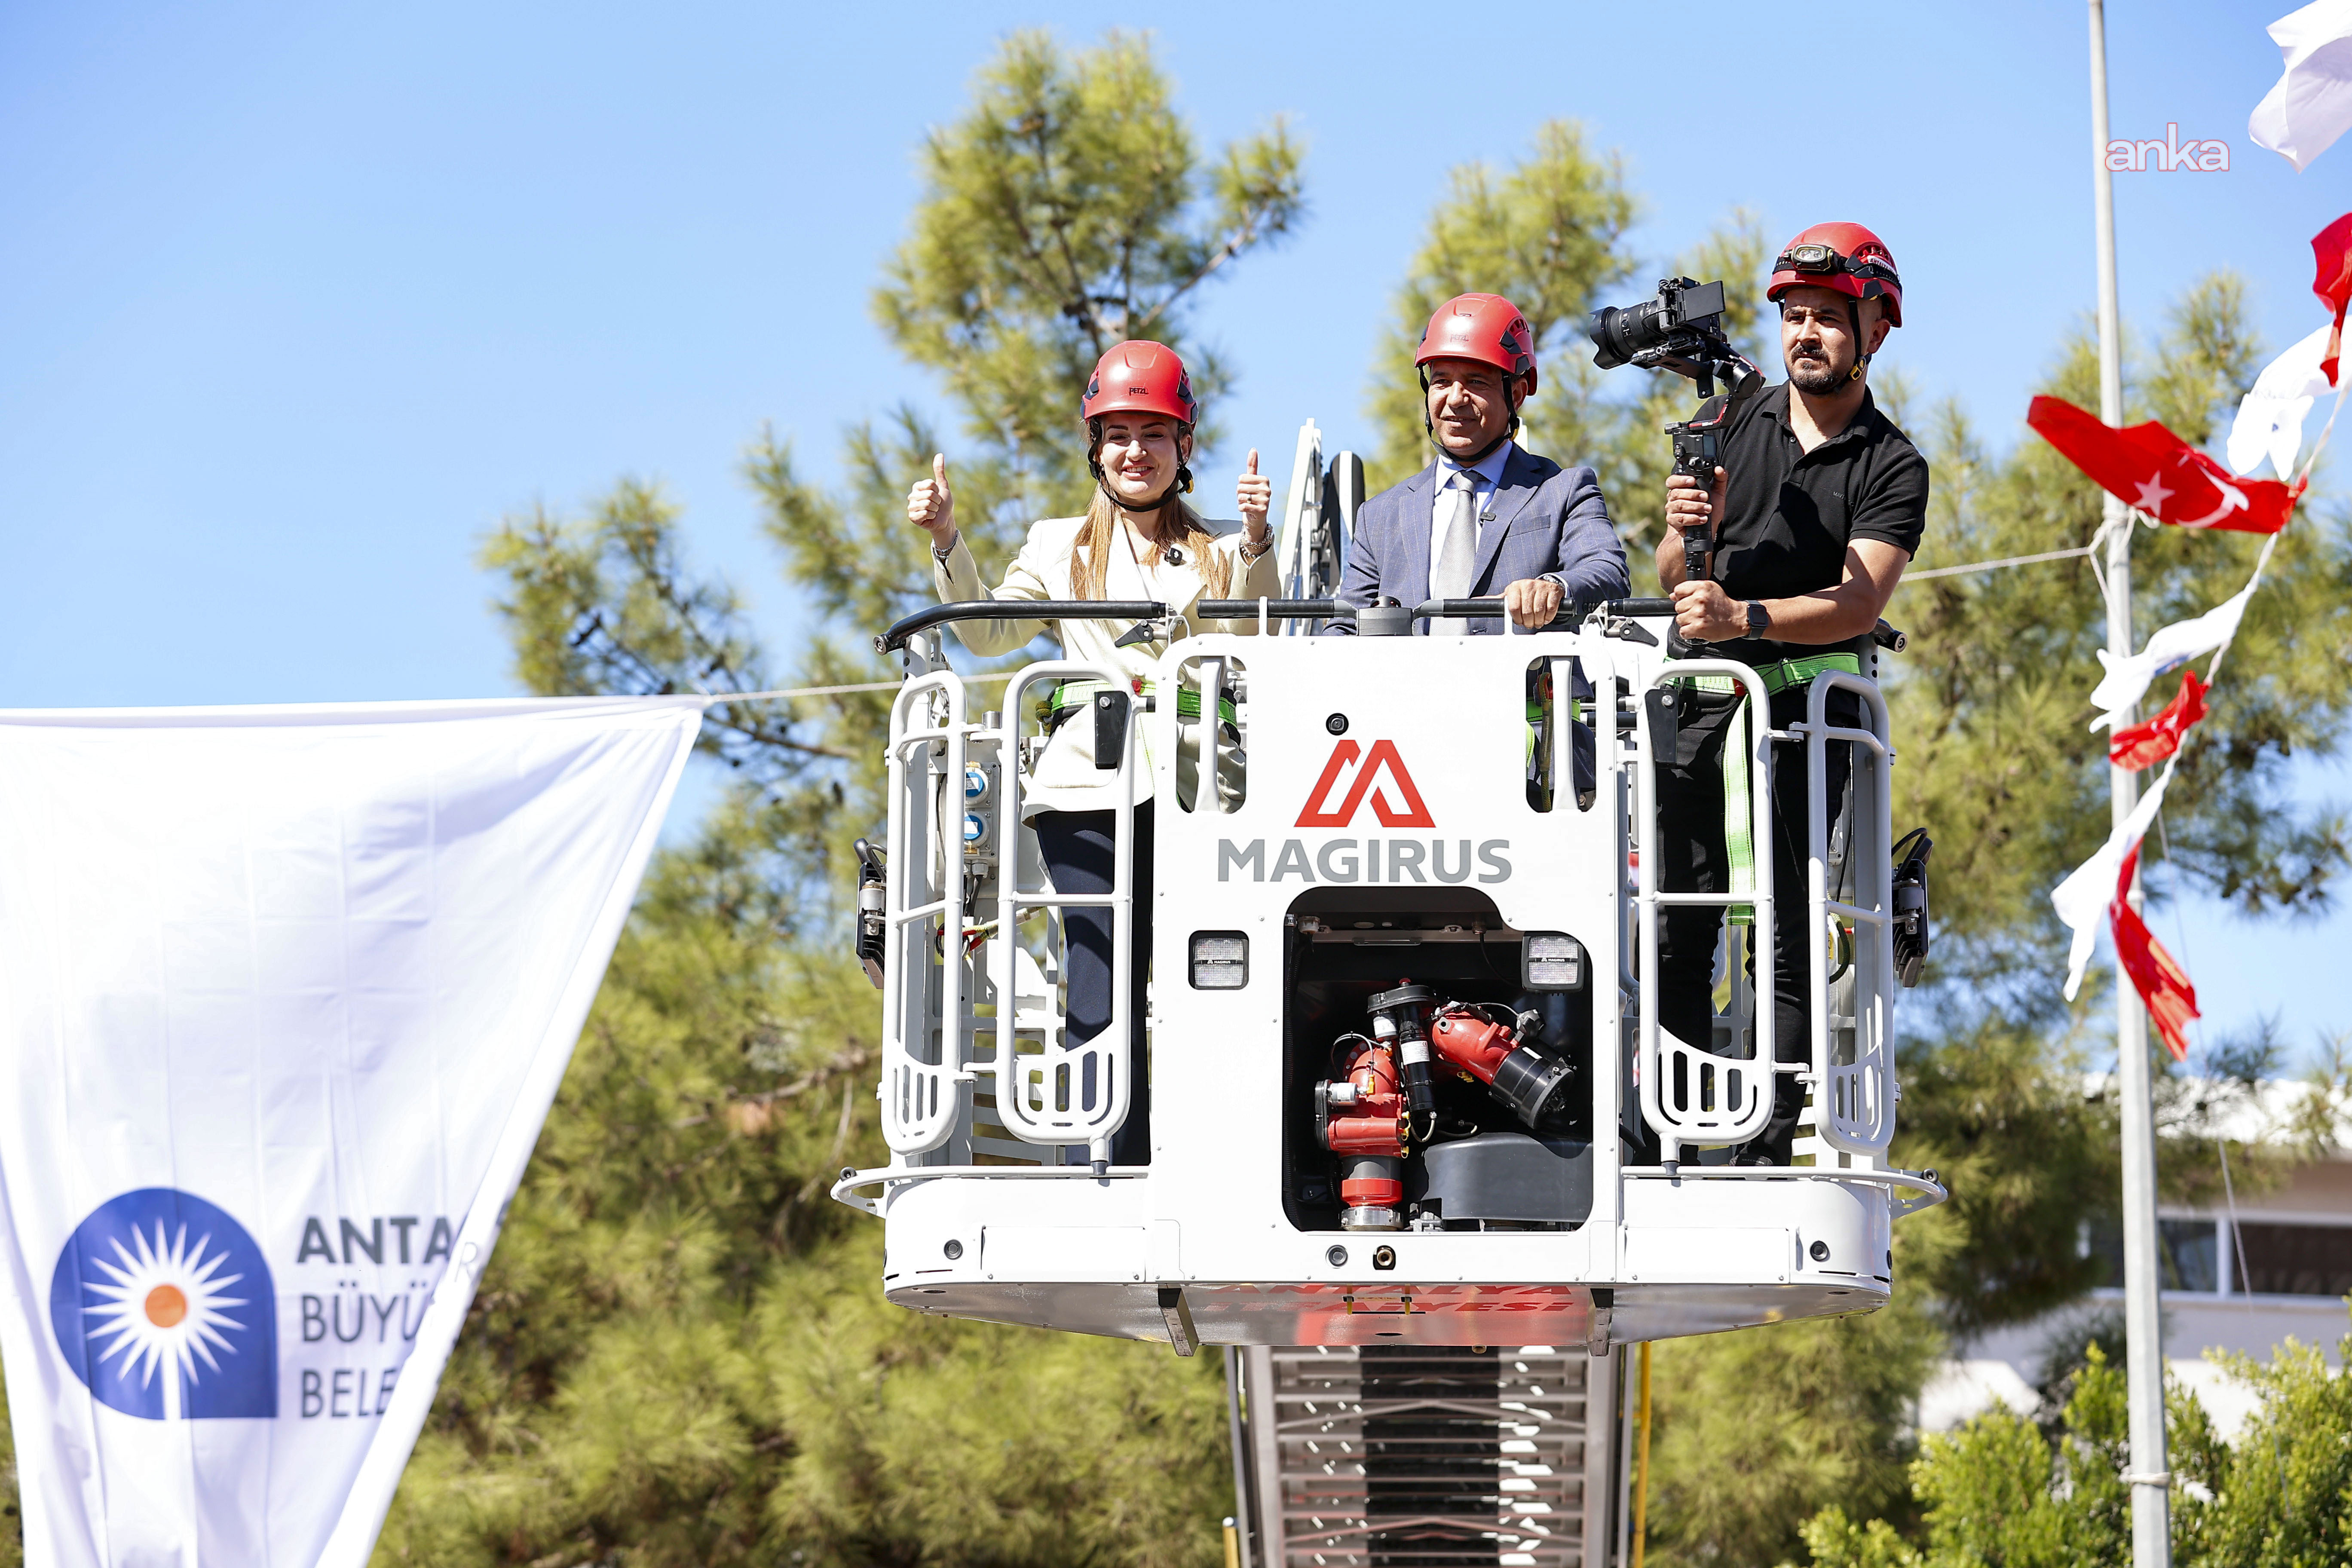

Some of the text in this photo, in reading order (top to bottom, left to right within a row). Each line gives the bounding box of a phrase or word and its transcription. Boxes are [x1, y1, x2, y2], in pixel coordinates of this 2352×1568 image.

[1129, 387, 1149, 396] PETZL
[1218, 839, 1512, 883] MAGIRUS
[1206, 1285, 1572, 1295] ANTALYA
[302, 1369, 397, 1418] BELE
